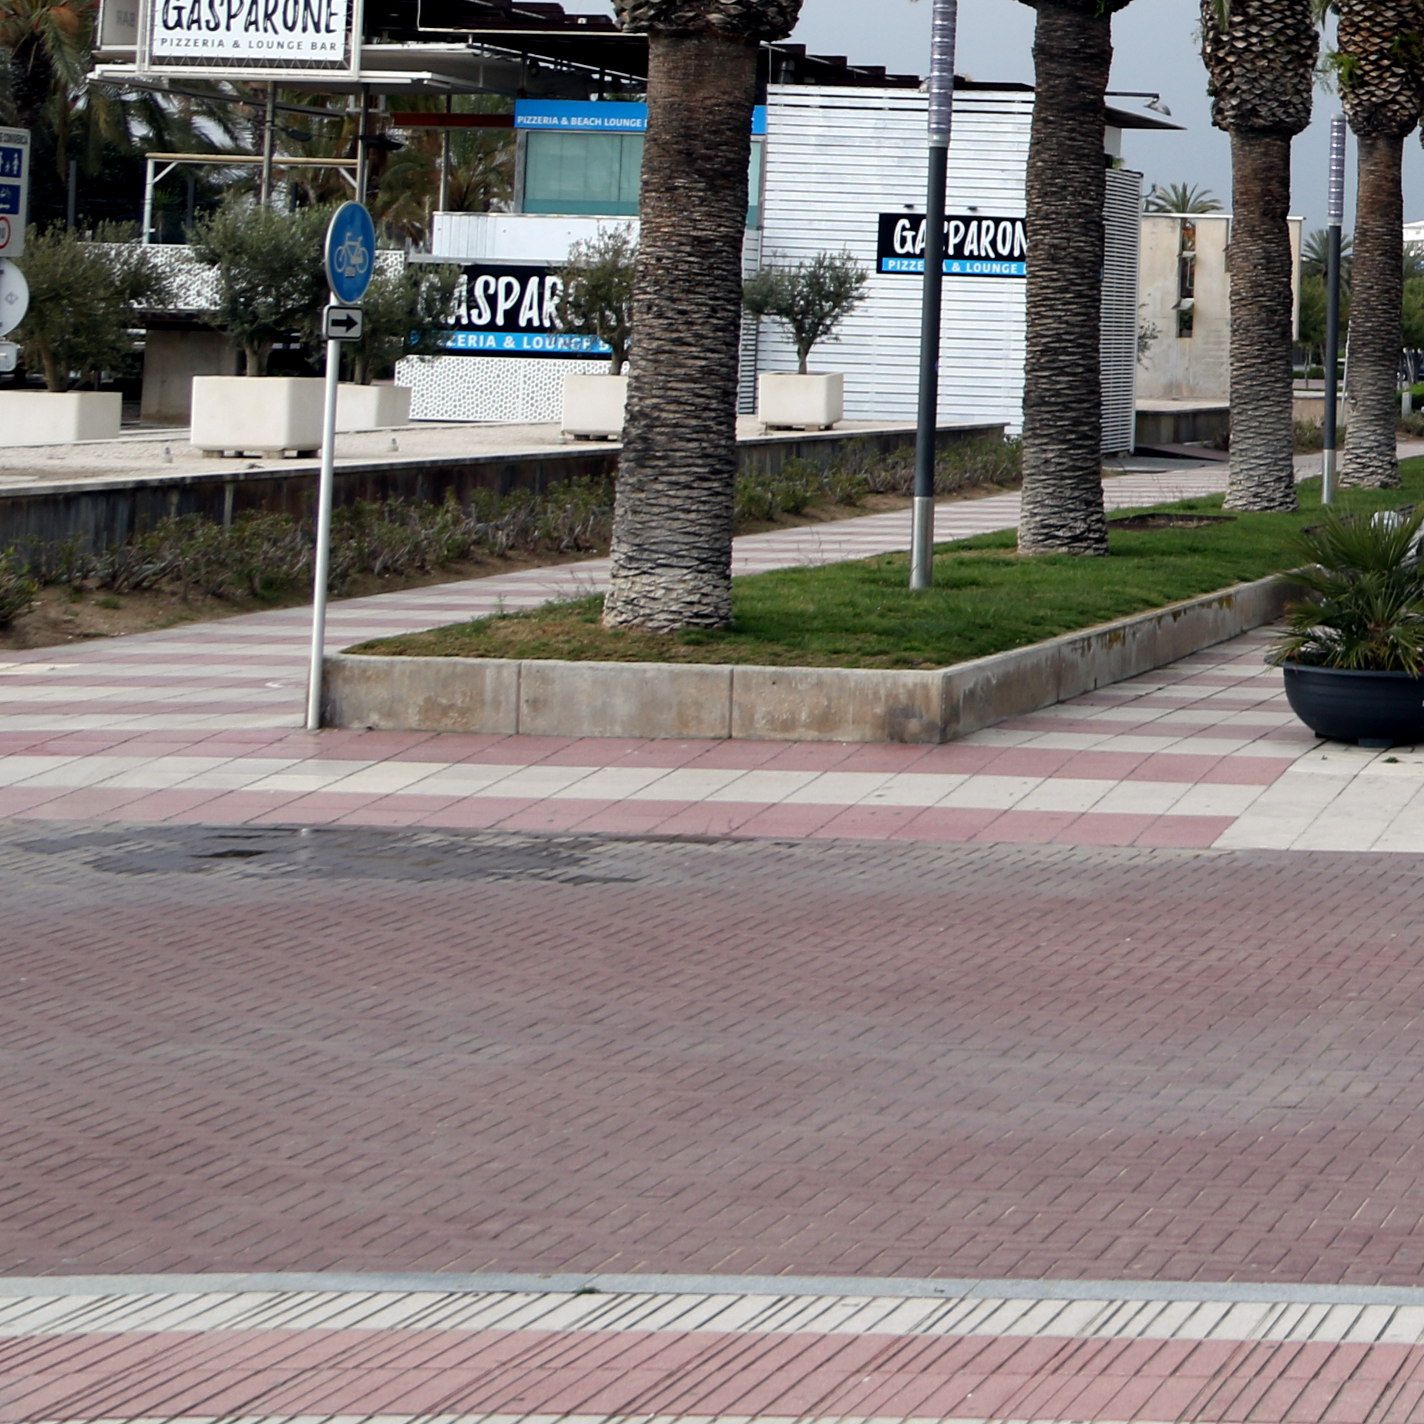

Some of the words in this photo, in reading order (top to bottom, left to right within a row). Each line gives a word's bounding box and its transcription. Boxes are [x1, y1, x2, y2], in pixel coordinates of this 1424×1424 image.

[160, 37, 225, 49] PIZZERIA
[232, 39, 241, 49] &
[248, 40, 303, 51] LOUNGE
[310, 41, 338, 52] BAR
[517, 115, 558, 126] PIZZERIA
[561, 117, 569, 126] &
[571, 116, 602, 127] BEACH
[604, 117, 642, 128] LOUNGE
[952, 263, 961, 273] &
[966, 263, 1018, 274] LOUNGE
[503, 335, 516, 348] &
